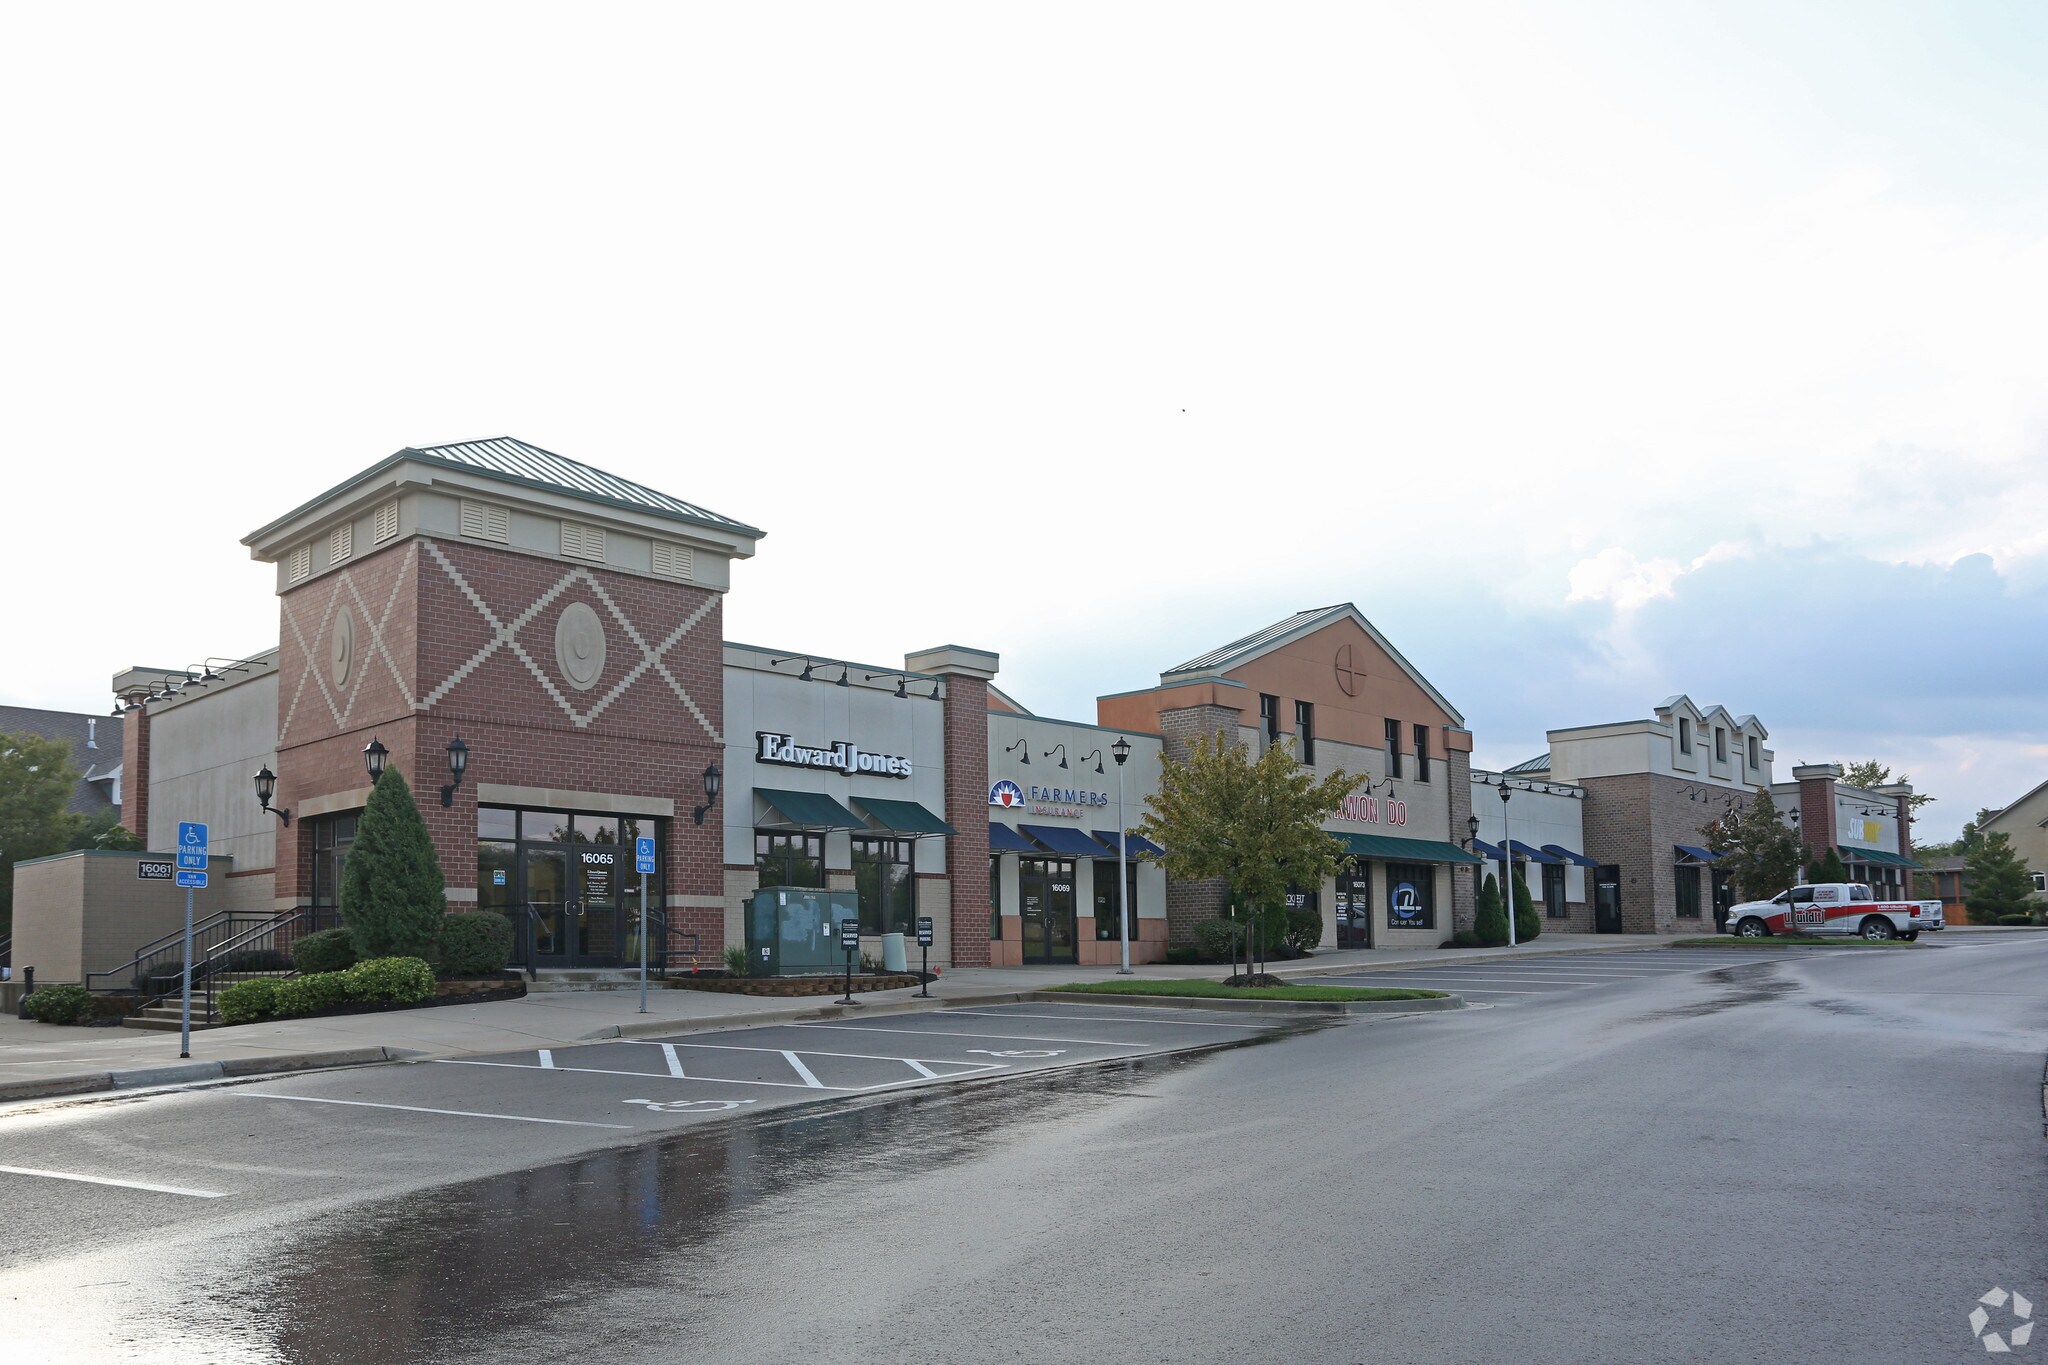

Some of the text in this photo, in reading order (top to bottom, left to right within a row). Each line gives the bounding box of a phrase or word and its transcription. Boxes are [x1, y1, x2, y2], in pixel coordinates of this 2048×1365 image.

[1030, 786, 1109, 806] FARMERS
[1031, 805, 1084, 818] INSURANCE
[1387, 799, 1407, 827] DO
[178, 845, 207, 855] PARKING
[183, 856, 201, 865] ONLY
[580, 853, 614, 864] 16065
[140, 864, 171, 873] 16061
[640, 862, 651, 870] ONLY
[1051, 883, 1070, 892] 16069
[1352, 881, 1366, 889] 16073
[1784, 911, 1823, 923] UuildIt
